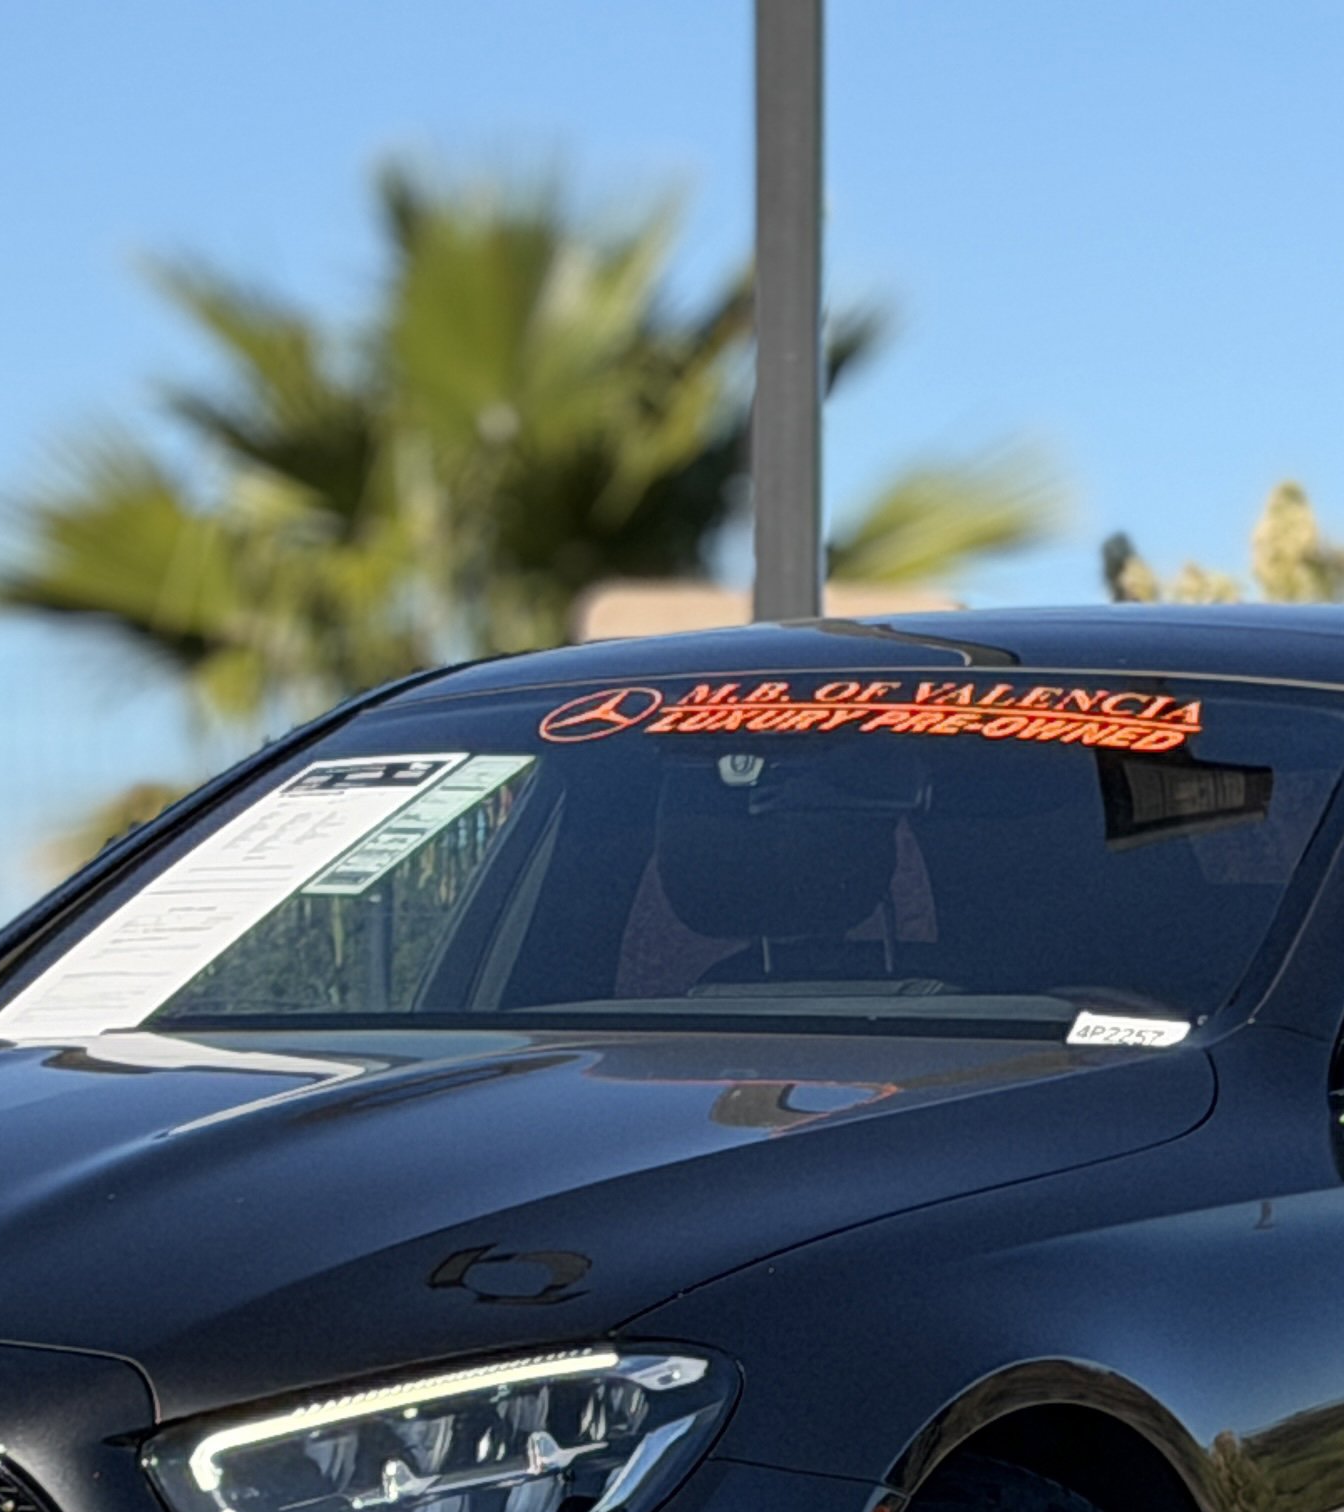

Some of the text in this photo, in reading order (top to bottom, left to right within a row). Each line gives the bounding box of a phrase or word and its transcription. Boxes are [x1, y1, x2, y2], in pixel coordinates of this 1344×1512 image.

[678, 680, 1203, 724] M.B. OF VALENCIA
[646, 707, 1185, 750] LUXURY PRE-OWNED
